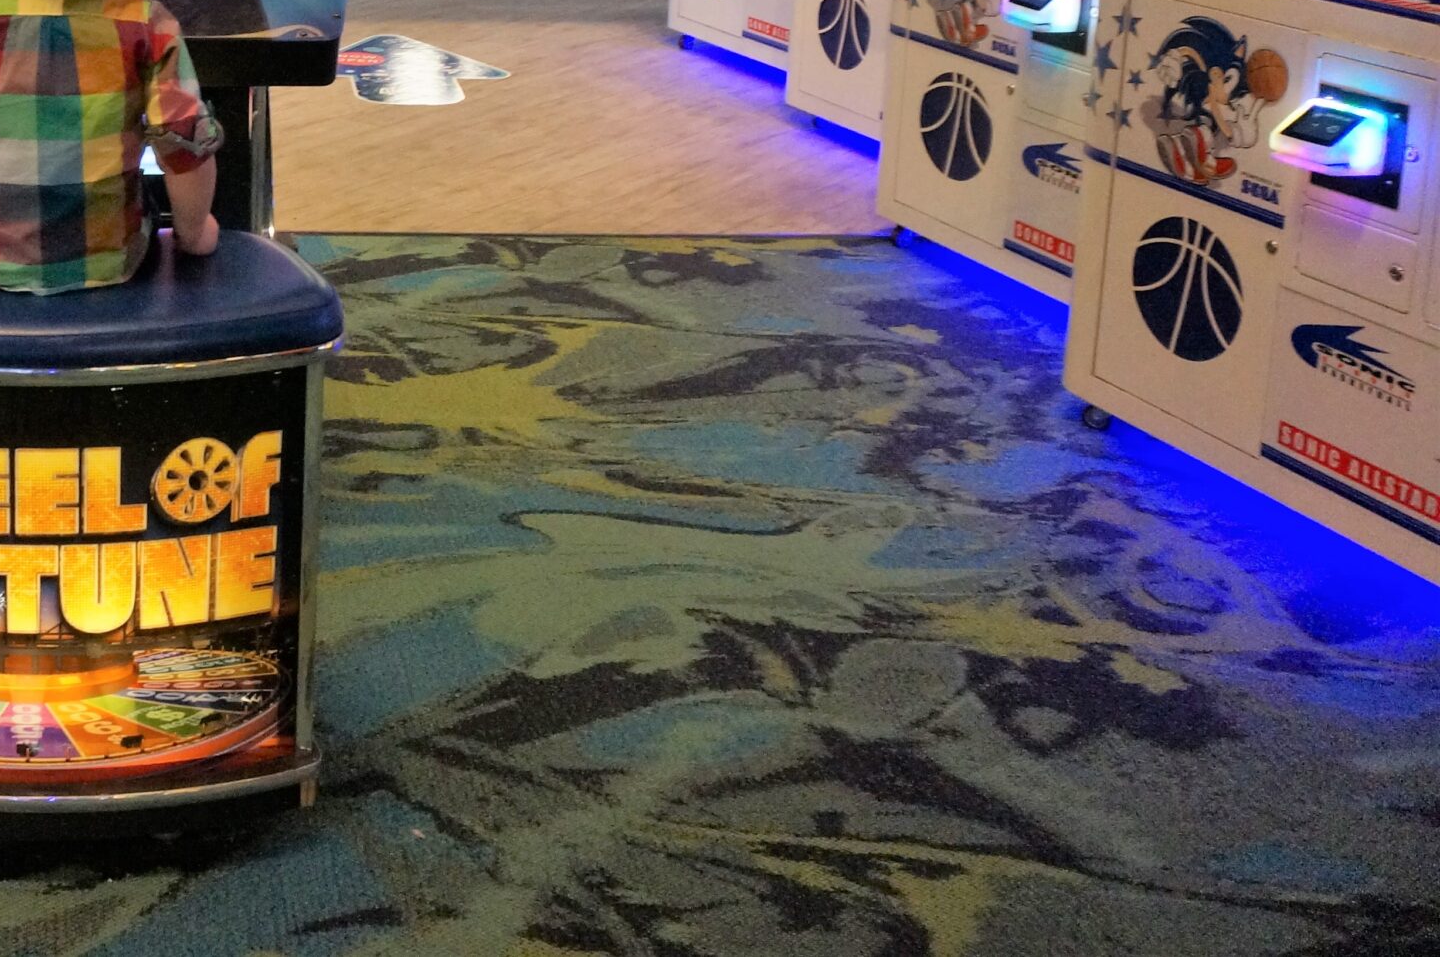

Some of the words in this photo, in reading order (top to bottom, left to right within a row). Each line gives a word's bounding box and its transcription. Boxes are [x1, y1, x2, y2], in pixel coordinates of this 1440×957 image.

[1241, 179, 1279, 205] SEGA
[1316, 343, 1416, 394] SONIC
[1279, 425, 1340, 468] SONIC
